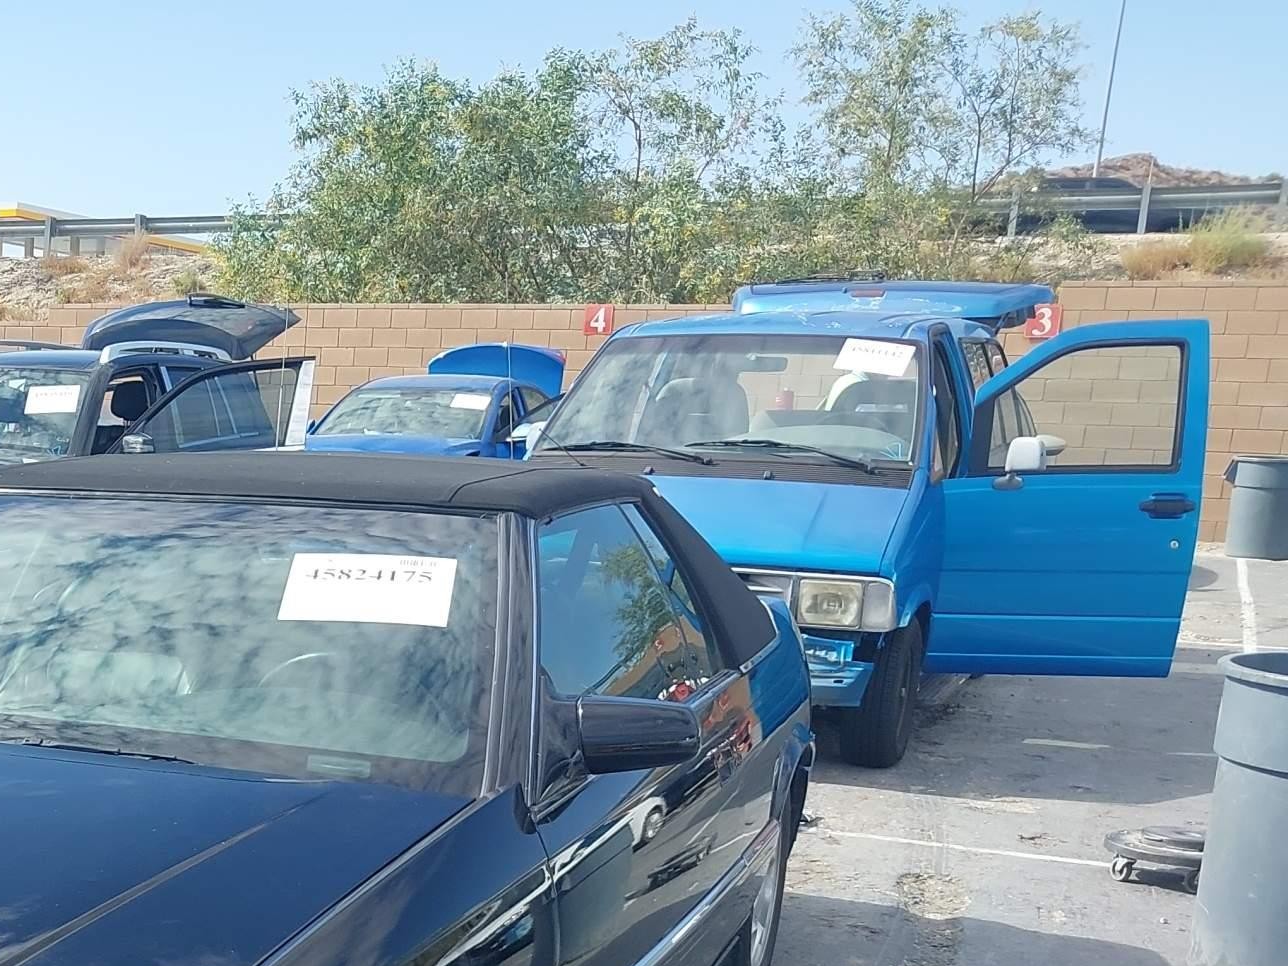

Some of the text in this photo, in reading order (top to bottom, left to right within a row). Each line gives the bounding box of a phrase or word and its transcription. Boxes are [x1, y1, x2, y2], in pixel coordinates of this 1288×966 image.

[589, 307, 606, 333] 4
[1031, 307, 1052, 335] 3
[305, 568, 433, 583] 45824175
